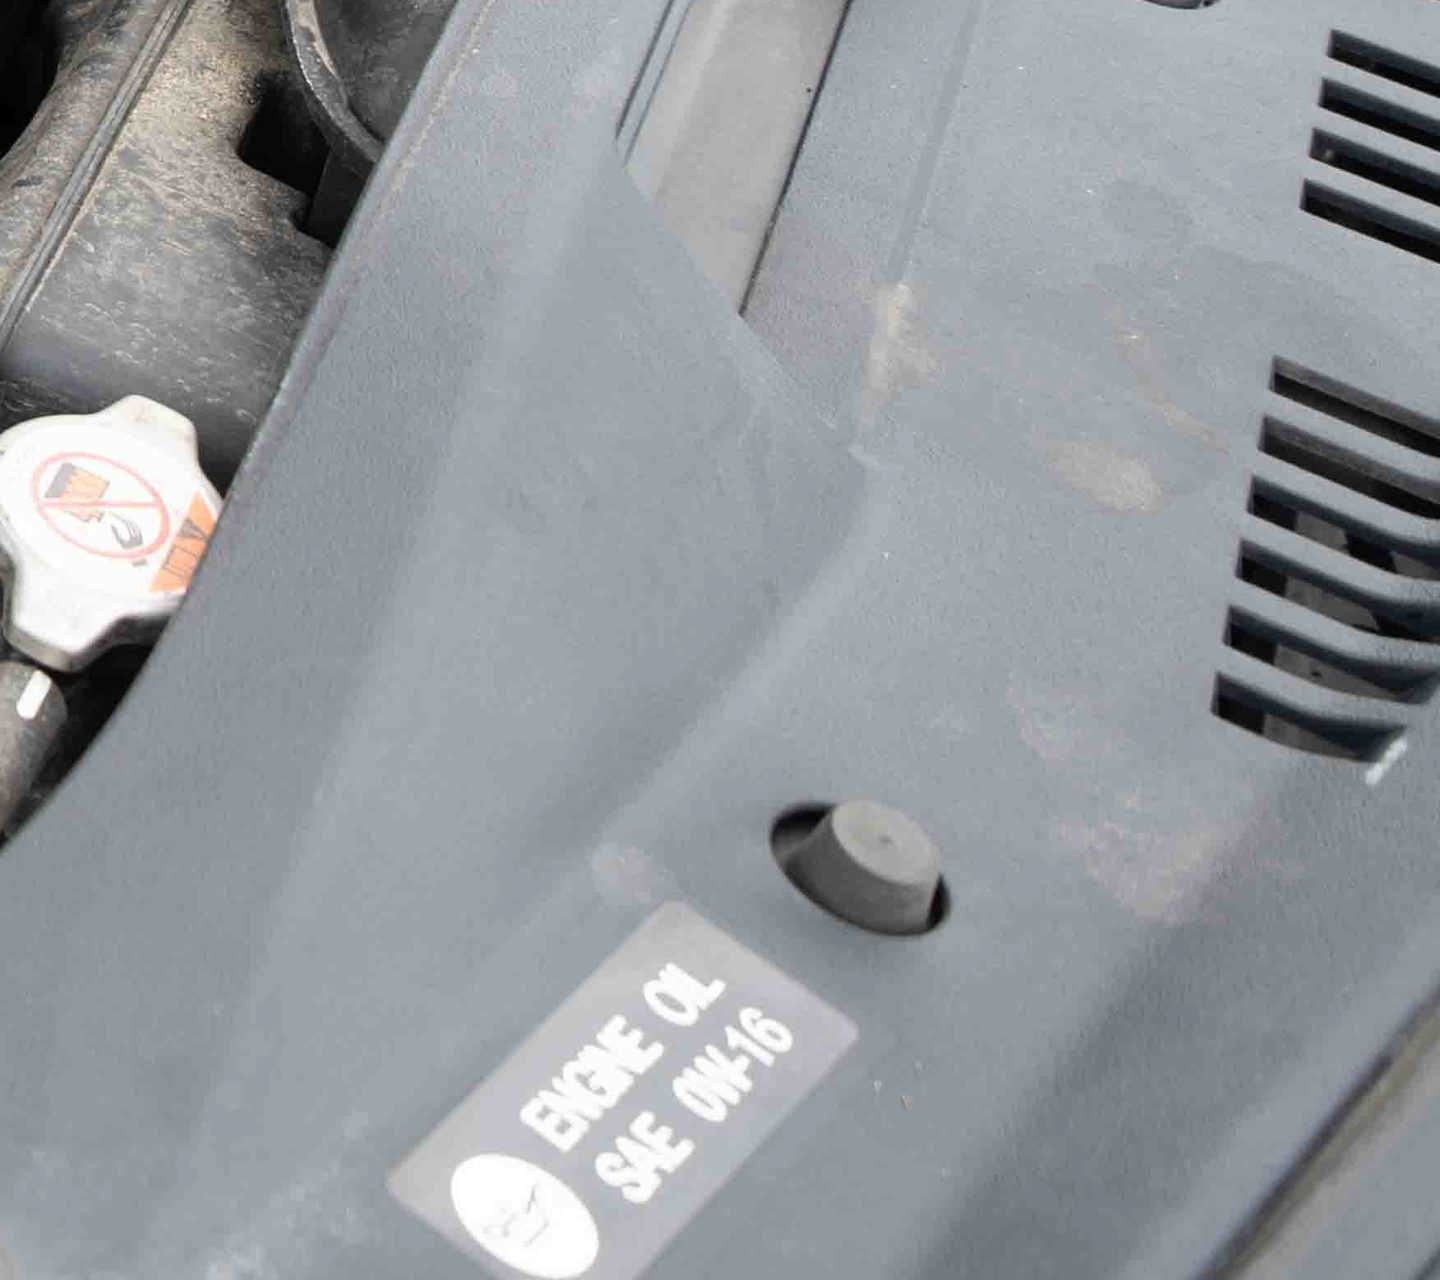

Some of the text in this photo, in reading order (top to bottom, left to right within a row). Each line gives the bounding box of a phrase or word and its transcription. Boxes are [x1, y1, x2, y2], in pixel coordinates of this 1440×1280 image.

[520, 962, 727, 1153] ENGINE OIL
[594, 1006, 794, 1204] SAE 0W-16
